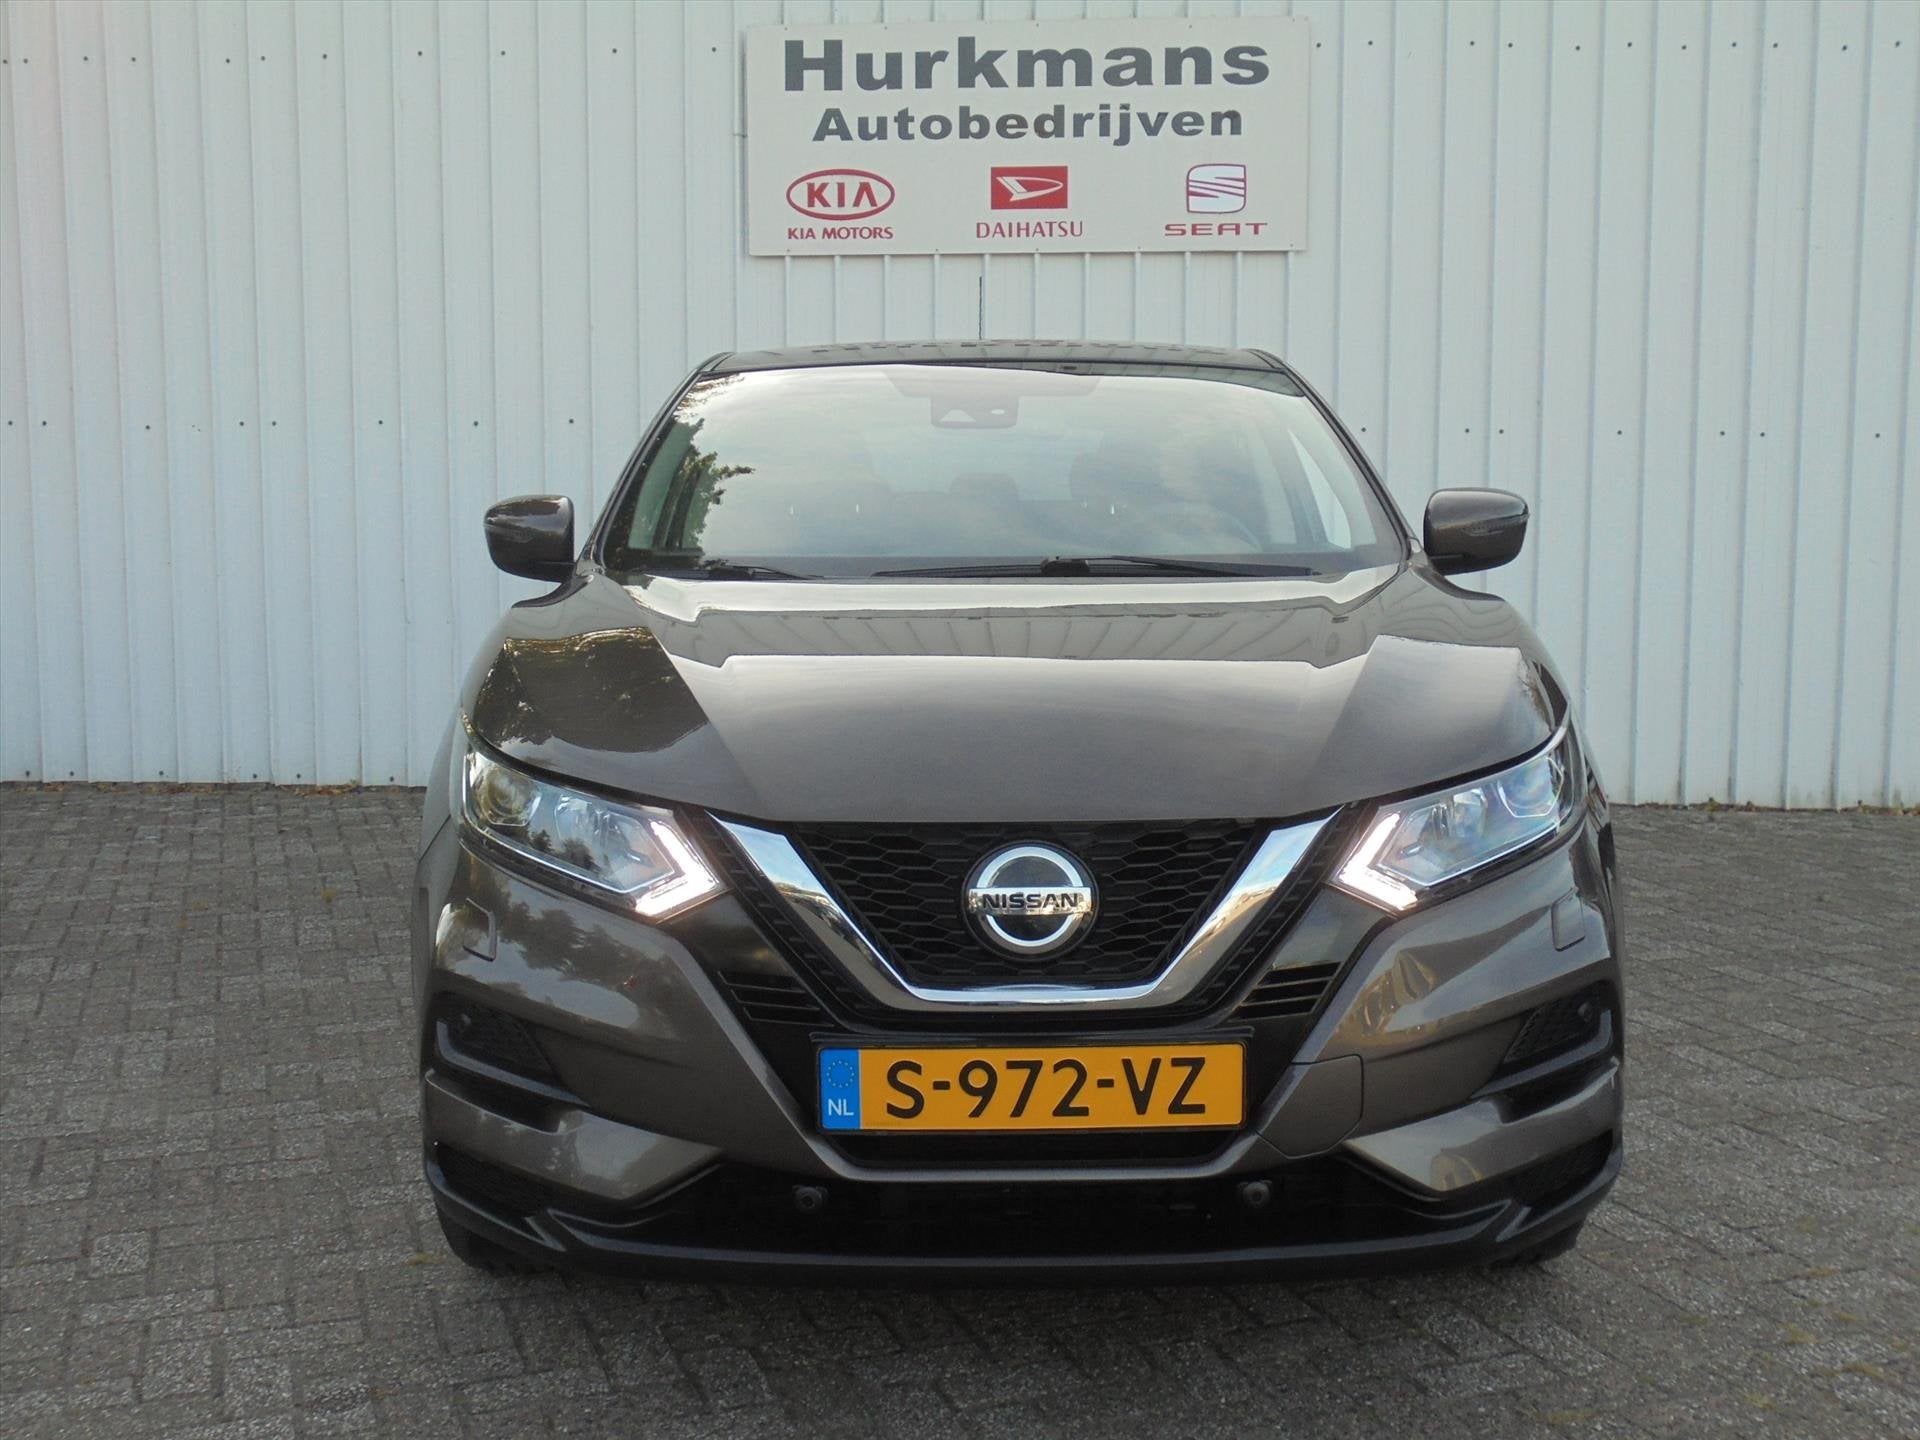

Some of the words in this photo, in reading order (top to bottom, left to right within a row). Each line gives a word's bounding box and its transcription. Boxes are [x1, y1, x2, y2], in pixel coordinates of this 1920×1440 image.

[784, 36, 1270, 91] Hurkmans
[813, 103, 1242, 147] Autobedrijven
[807, 182, 878, 208] KIA
[787, 227, 819, 240] KIA
[822, 227, 894, 240] MOTORS
[976, 221, 1084, 238] DAIHATSU
[1165, 223, 1268, 236] SEAT
[982, 892, 1079, 909] NISSAN
[886, 1057, 1206, 1119] S-972-VZ
[828, 1099, 854, 1117] NL
